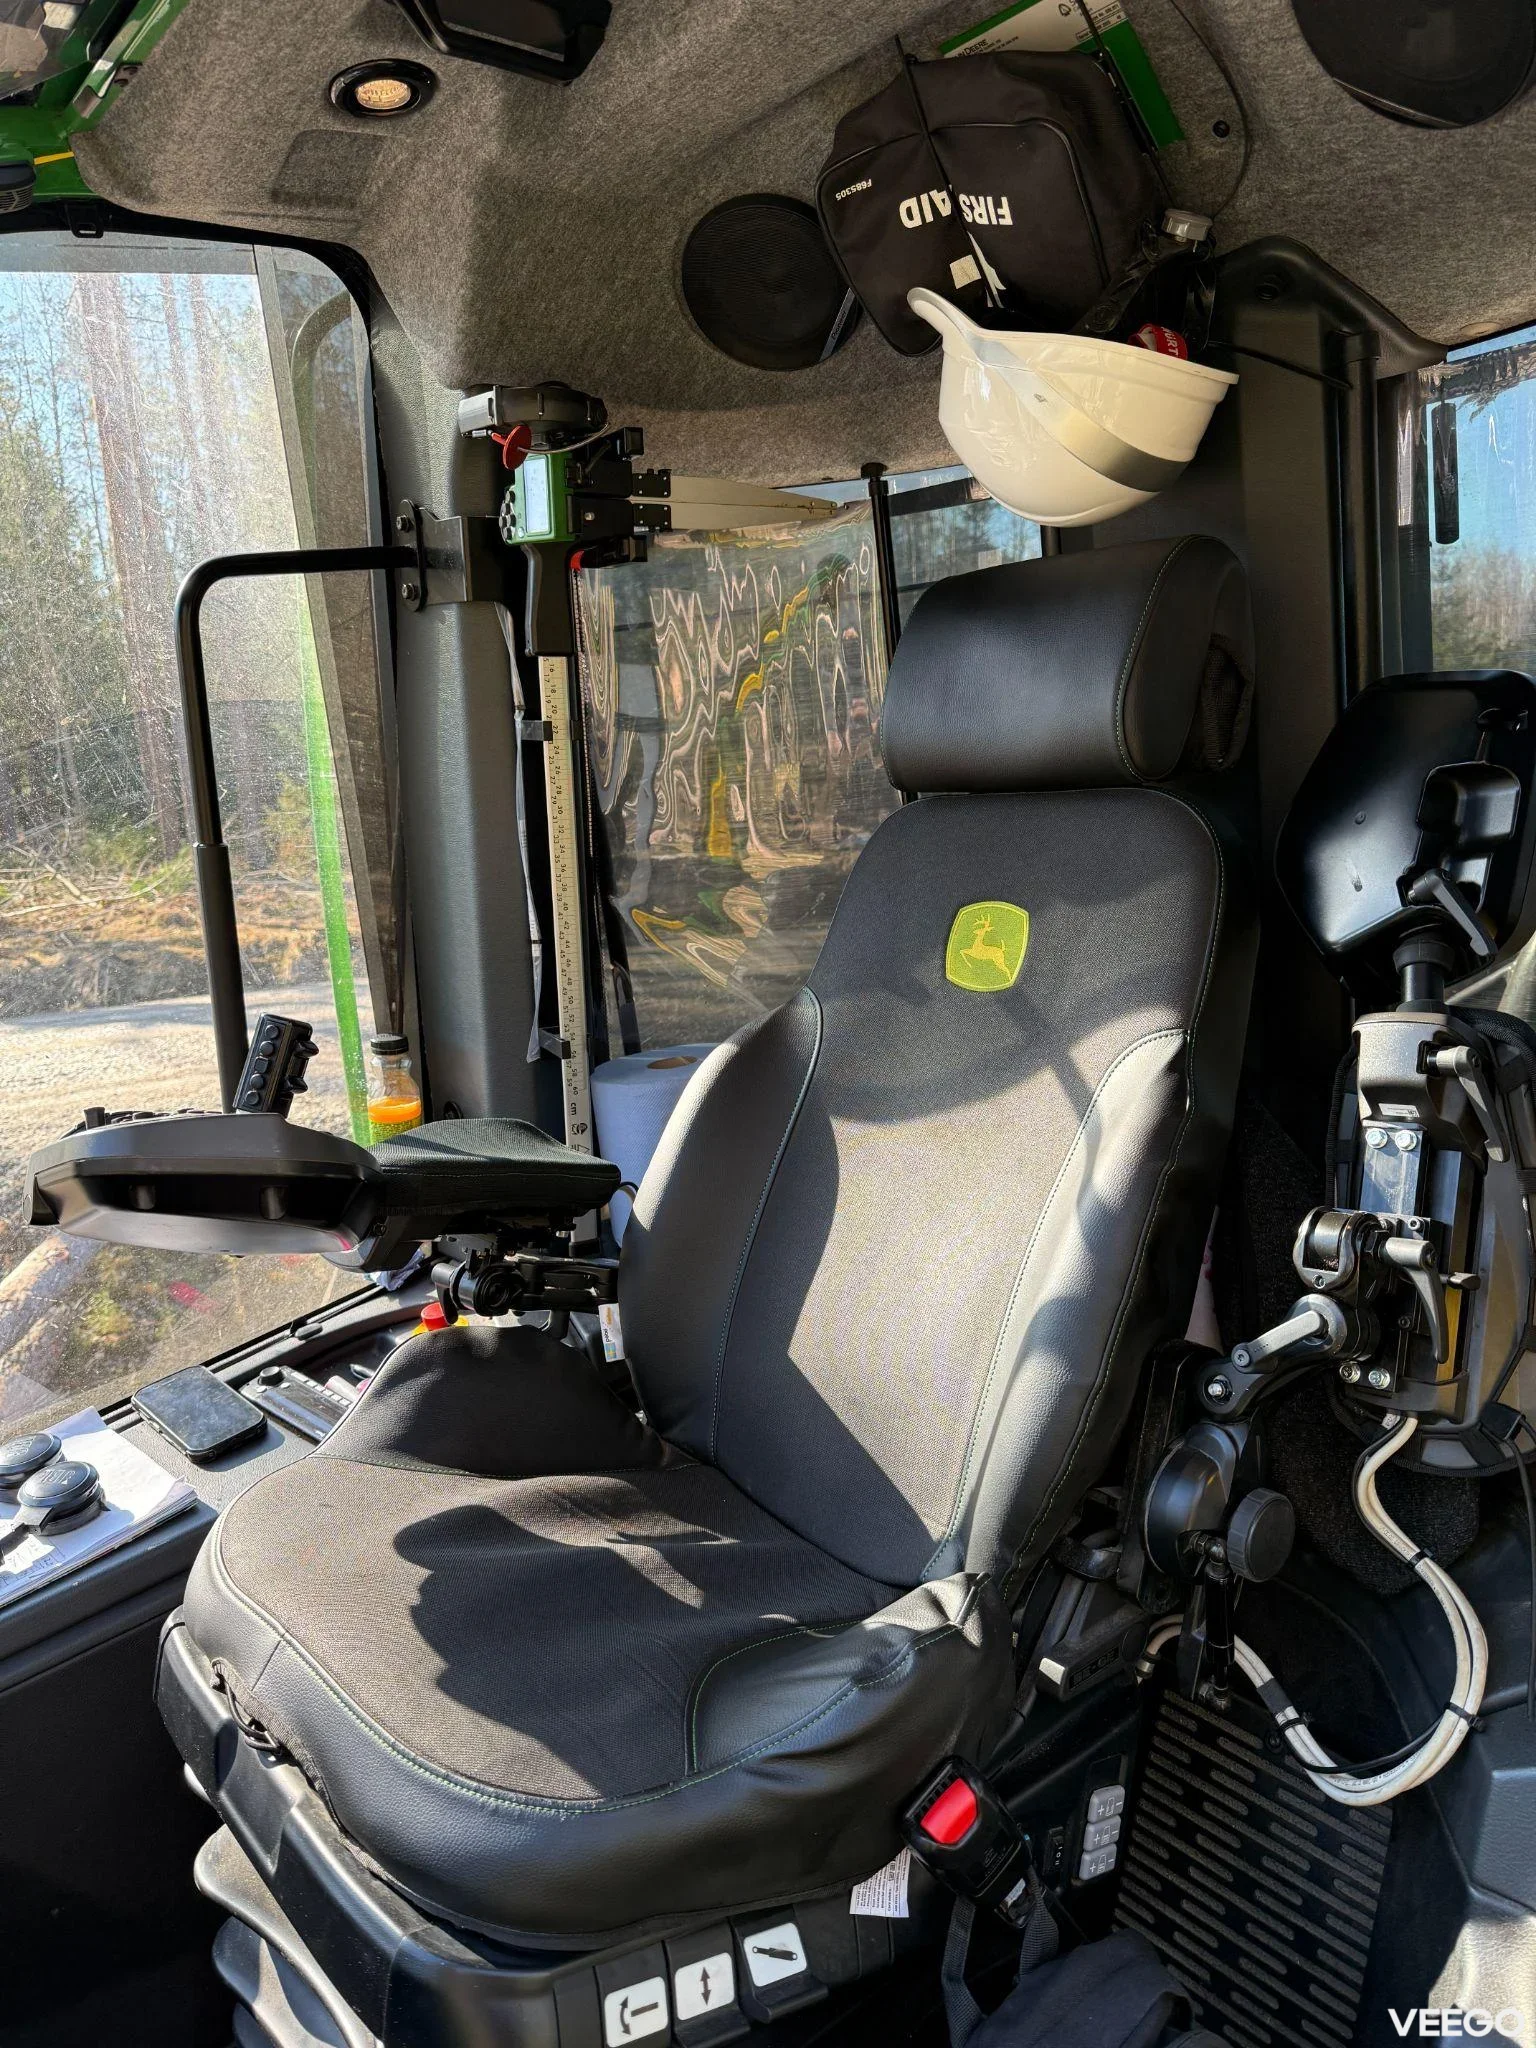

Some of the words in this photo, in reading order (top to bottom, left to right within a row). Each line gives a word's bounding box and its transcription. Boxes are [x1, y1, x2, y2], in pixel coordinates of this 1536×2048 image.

[964, 39, 989, 55] DEERE
[835, 178, 873, 201] F685305
[899, 188, 952, 229] AID
[957, 192, 1013, 226] FIRS
[550, 664, 555, 672] 16
[544, 674, 550, 682] 17
[551, 685, 556, 694] 18
[545, 696, 551, 704] 19
[552, 704, 558, 714] 20
[553, 725, 558, 734] 22
[554, 746, 560, 754] 24
[549, 756, 554, 764] 25
[555, 766, 560, 774] 26
[550, 776, 556, 784] 27
[556, 786, 562, 794] 28
[551, 796, 556, 804] 29
[558, 806, 563, 814] 30
[552, 816, 558, 824] 31
[558, 824, 564, 834] 32
[554, 834, 559, 844] 33
[560, 844, 566, 854] 34
[554, 854, 560, 864] 35
[560, 864, 566, 872] 36
[556, 874, 562, 882] 37
[562, 883, 567, 892] 38
[556, 892, 562, 902] 39
[563, 902, 568, 911] 40
[558, 912, 564, 920] 41
[564, 920, 570, 930] 42
[559, 930, 564, 940] 43
[561, 968, 566, 976] 47
[562, 986, 568, 996] 49
[568, 995, 574, 1004] 50
[563, 1006, 568, 1014] 51
[569, 1014, 574, 1022] 52
[566, 1060, 572, 1068] 57
[572, 1068, 578, 1076] 58
[567, 1078, 572, 1086] 59
[573, 1086, 578, 1095] 60
[570, 1102, 577, 1116] cm
